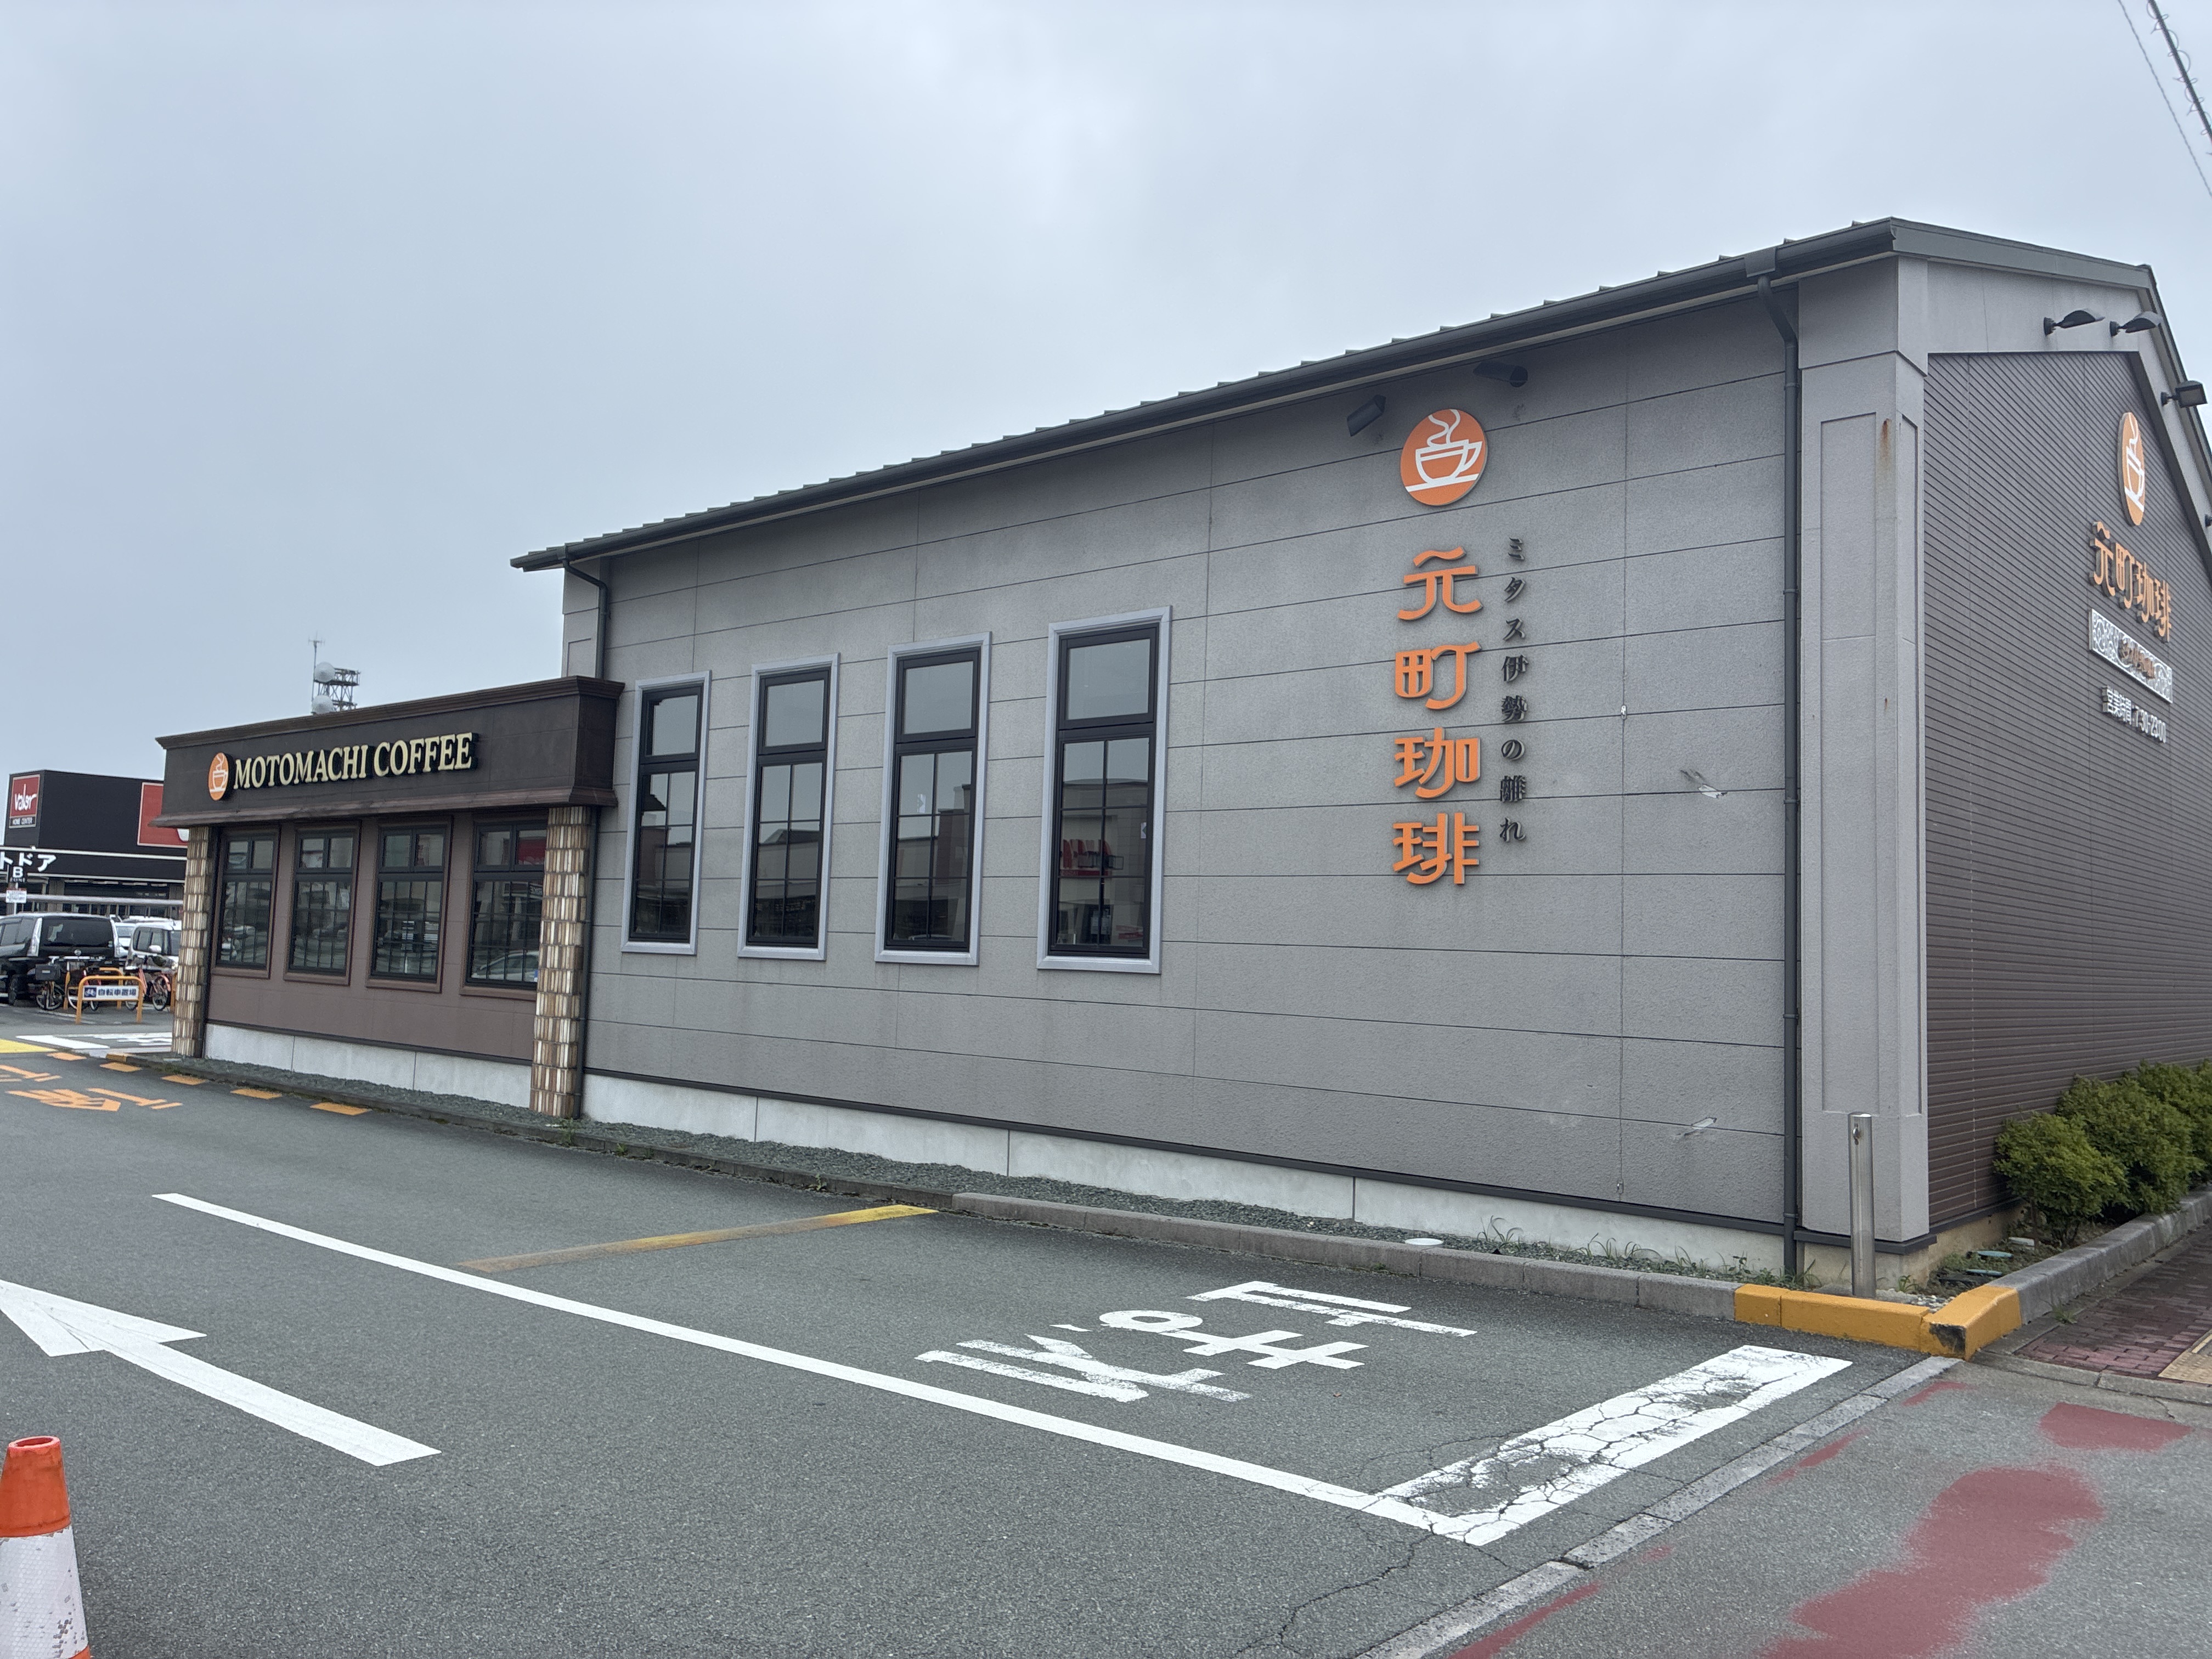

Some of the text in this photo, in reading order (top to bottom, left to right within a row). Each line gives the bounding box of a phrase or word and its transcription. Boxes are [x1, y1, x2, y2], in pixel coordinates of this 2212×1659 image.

[2093, 521, 2171, 642] 元町珈琲
[1393, 546, 1482, 885] 元町珈琲
[1499, 537, 1528, 843] ミタス伊勢の離れ
[233, 732, 473, 790] MOTOMACHI COFFEE
[13, 866, 23, 878] B
[914, 1280, 1478, 1403] 止まれ
